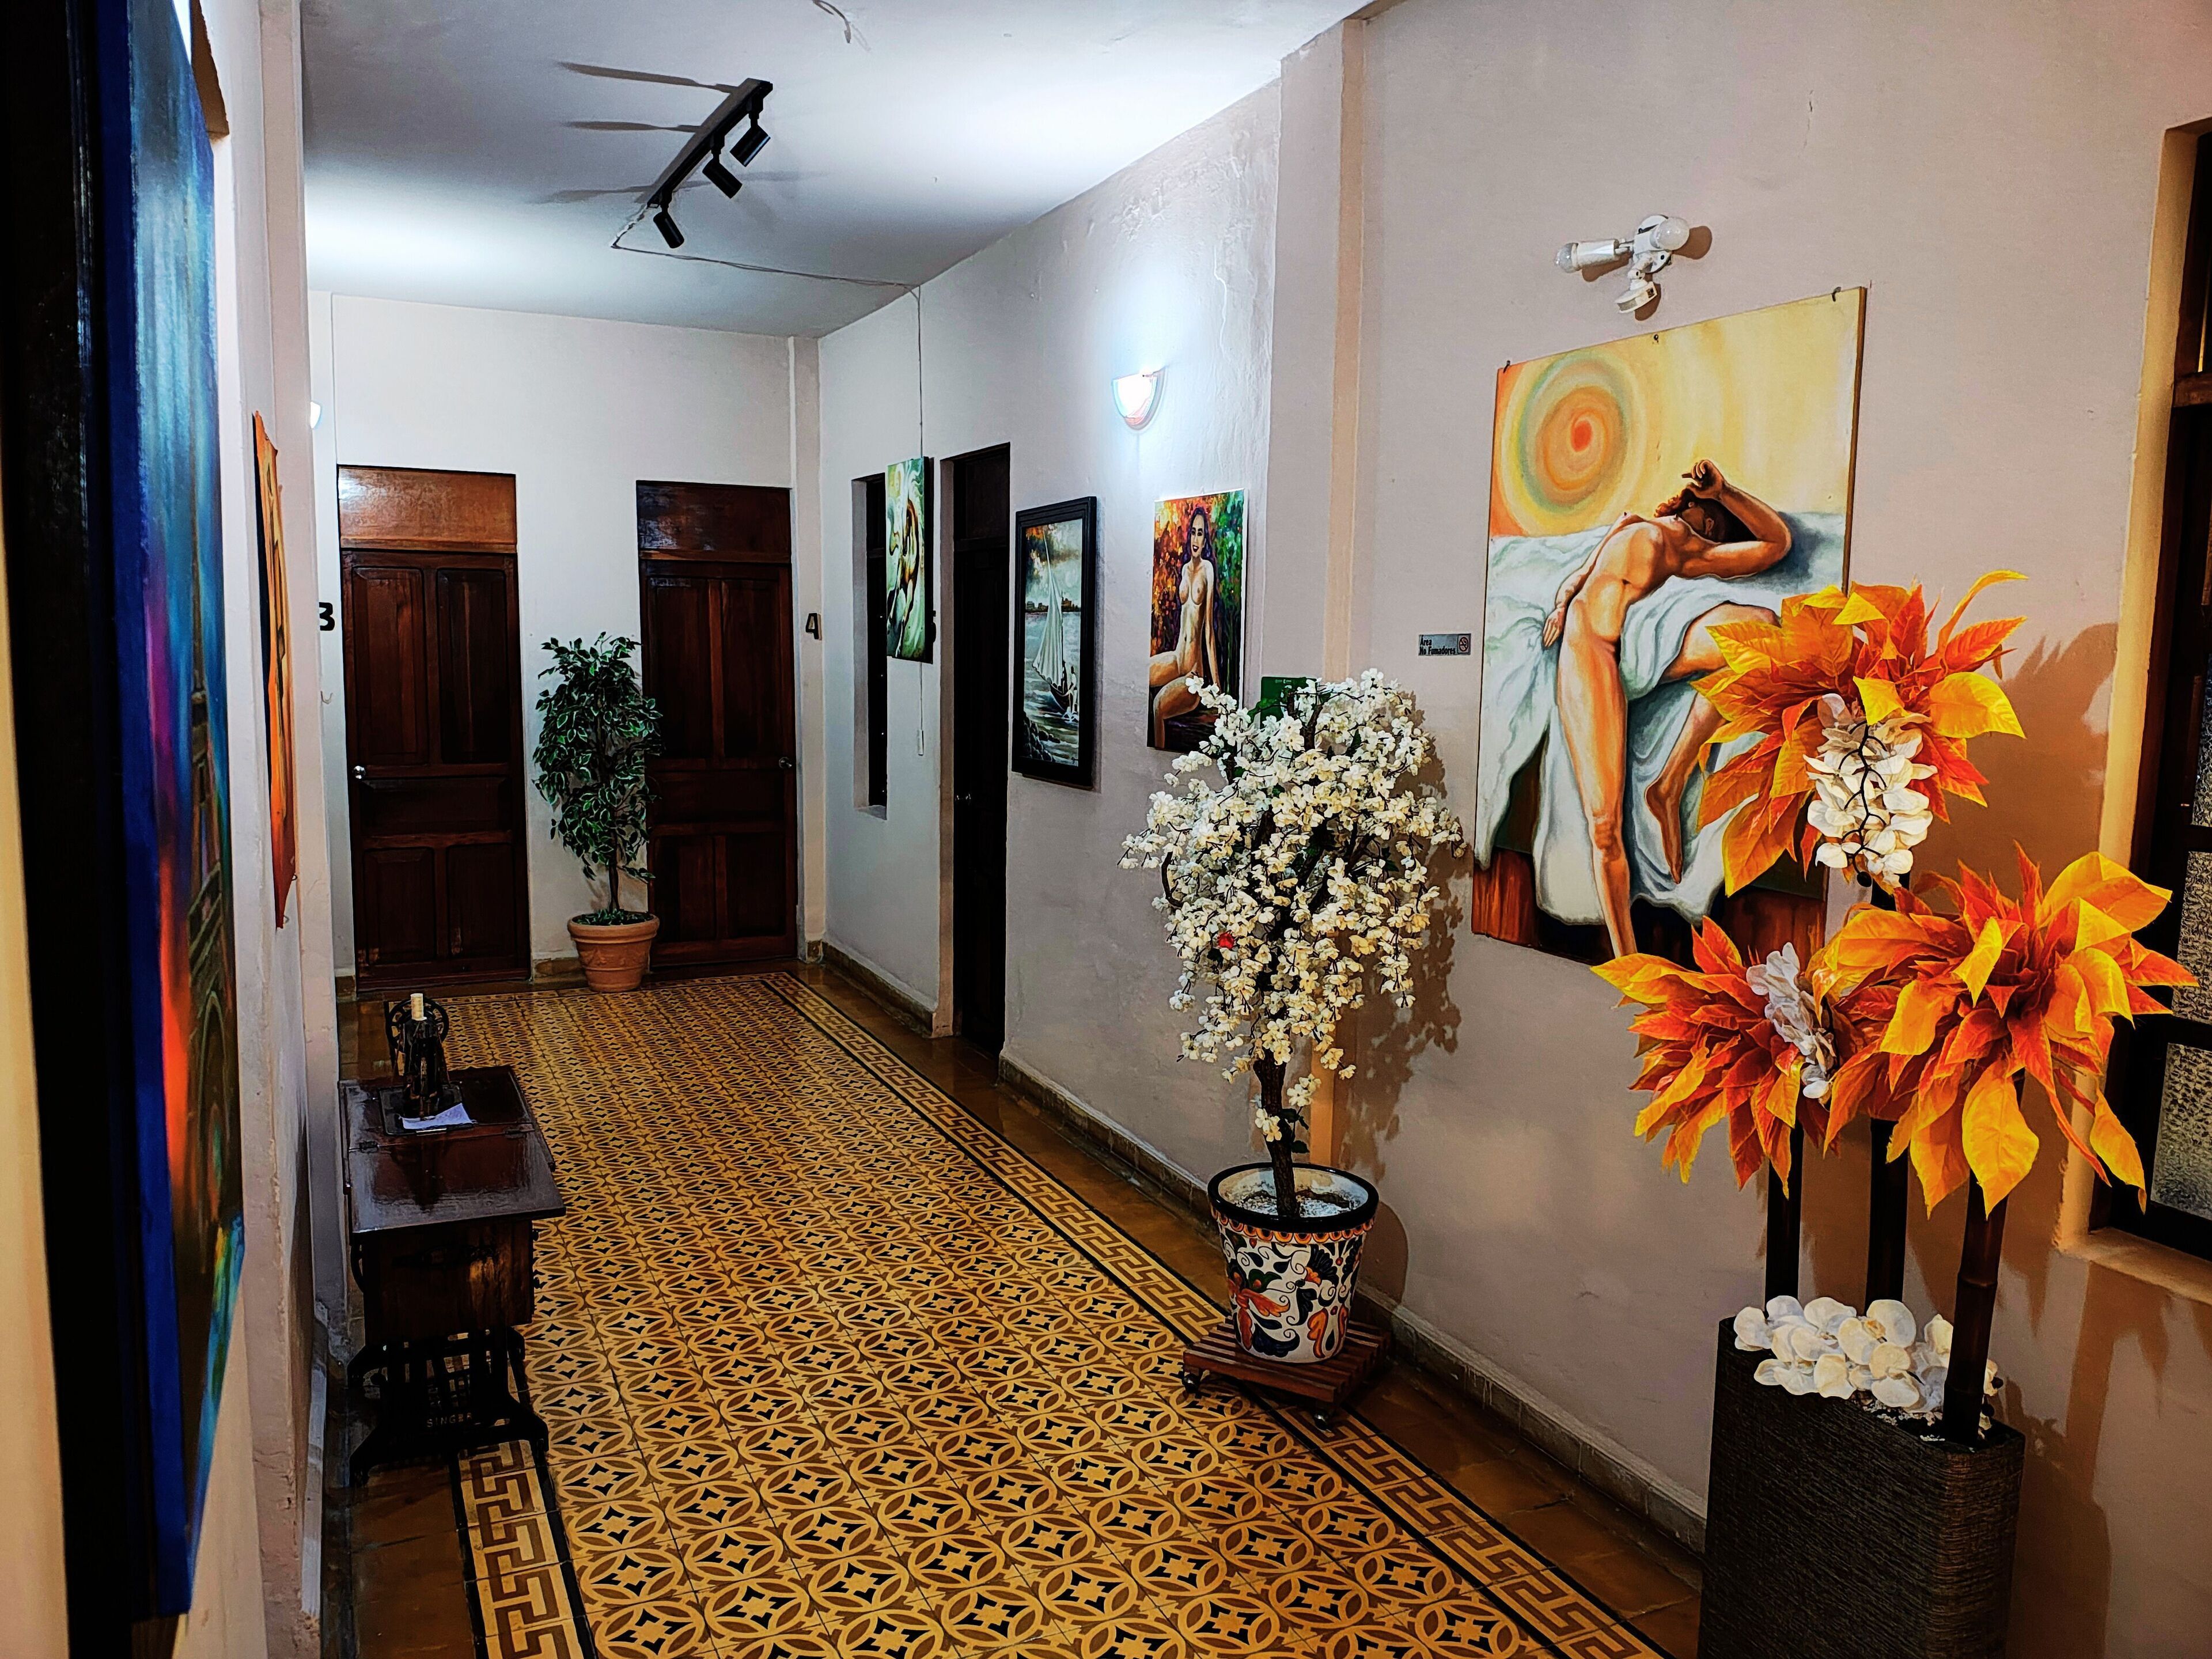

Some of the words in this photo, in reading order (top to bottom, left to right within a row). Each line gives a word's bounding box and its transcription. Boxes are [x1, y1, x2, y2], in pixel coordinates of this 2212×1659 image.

[319, 602, 335, 631] 3
[805, 613, 819, 639] 4
[1419, 646, 1426, 654] No
[1428, 646, 1456, 655] Fumadores
[426, 1411, 474, 1428] SINGER
